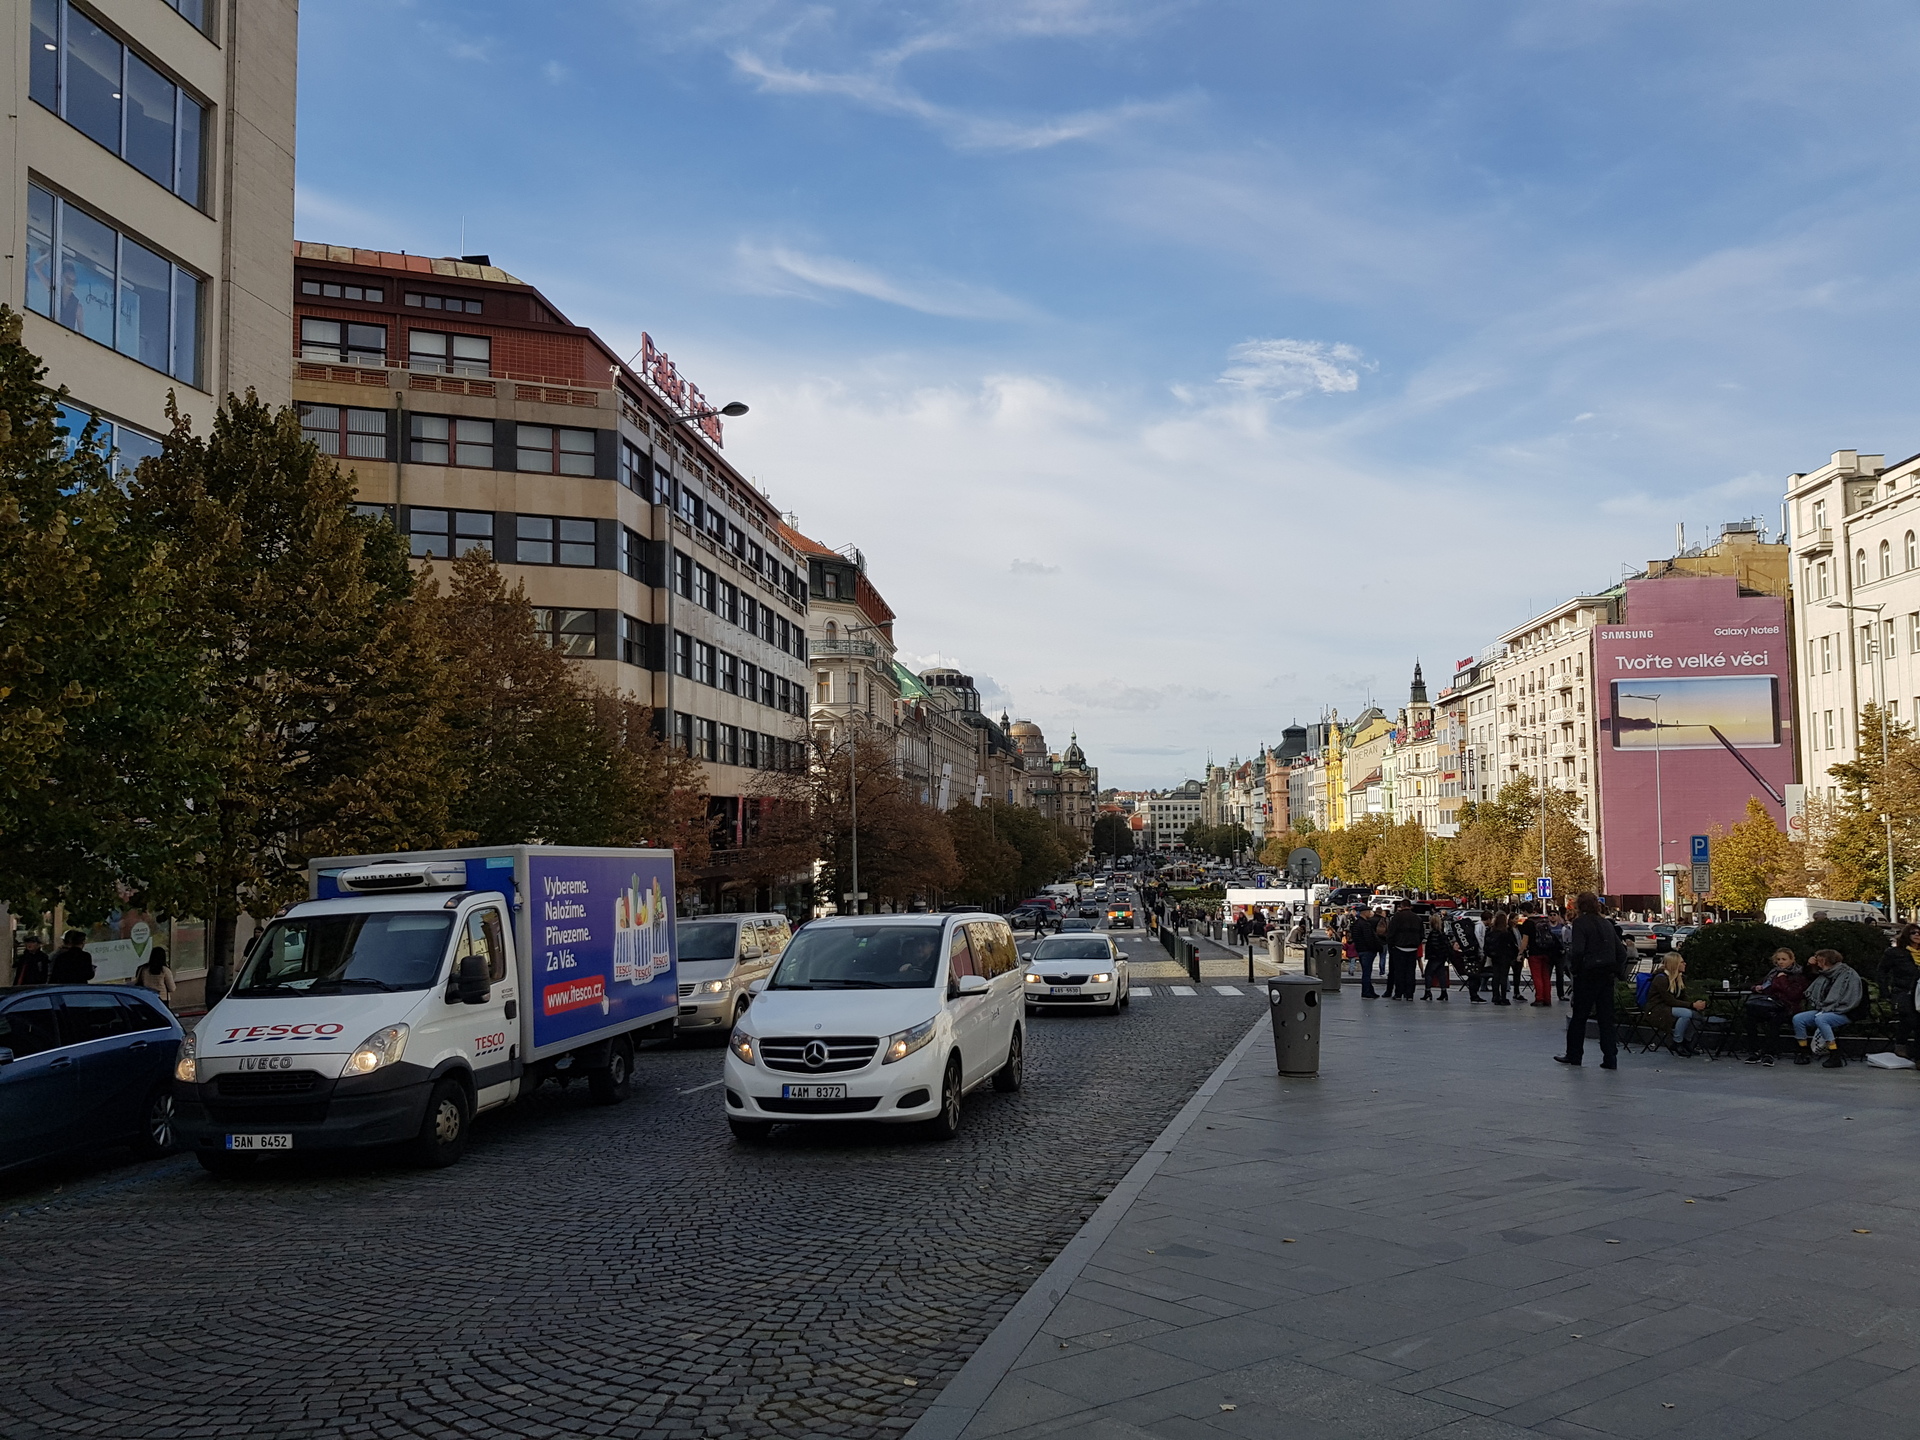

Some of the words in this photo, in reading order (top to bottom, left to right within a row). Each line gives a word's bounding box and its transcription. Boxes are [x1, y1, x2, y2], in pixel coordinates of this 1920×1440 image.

[1601, 630, 1654, 640] SAMSUNG
[1714, 627, 1748, 637] Galaxy
[1750, 626, 1780, 635] Note8
[1615, 654, 1673, 670] Tvořte
[1677, 652, 1726, 668] velké
[1730, 651, 1769, 666] věci
[1354, 745, 1378, 761] MERAN
[1694, 838, 1705, 855] P
[544, 876, 589, 900] Vybereme.
[545, 900, 587, 921] Naložíme.
[546, 925, 592, 946] Přivezeme.
[1454, 922, 1470, 947] adidas
[546, 951, 559, 972] Za
[559, 949, 577, 968] Vás.
[653, 955, 668, 966] TESCO
[634, 965, 652, 978] TESCO
[547, 983, 602, 1008] www.itesco.cz
[225, 1023, 344, 1039] TESCO
[474, 1032, 505, 1050] TESCO
[239, 1056, 293, 1070] IVECO
[791, 1087, 809, 1098] 4AM
[816, 1087, 841, 1098] 8372
[234, 1136, 253, 1148] 5AN
[260, 1136, 287, 1147] 6452
